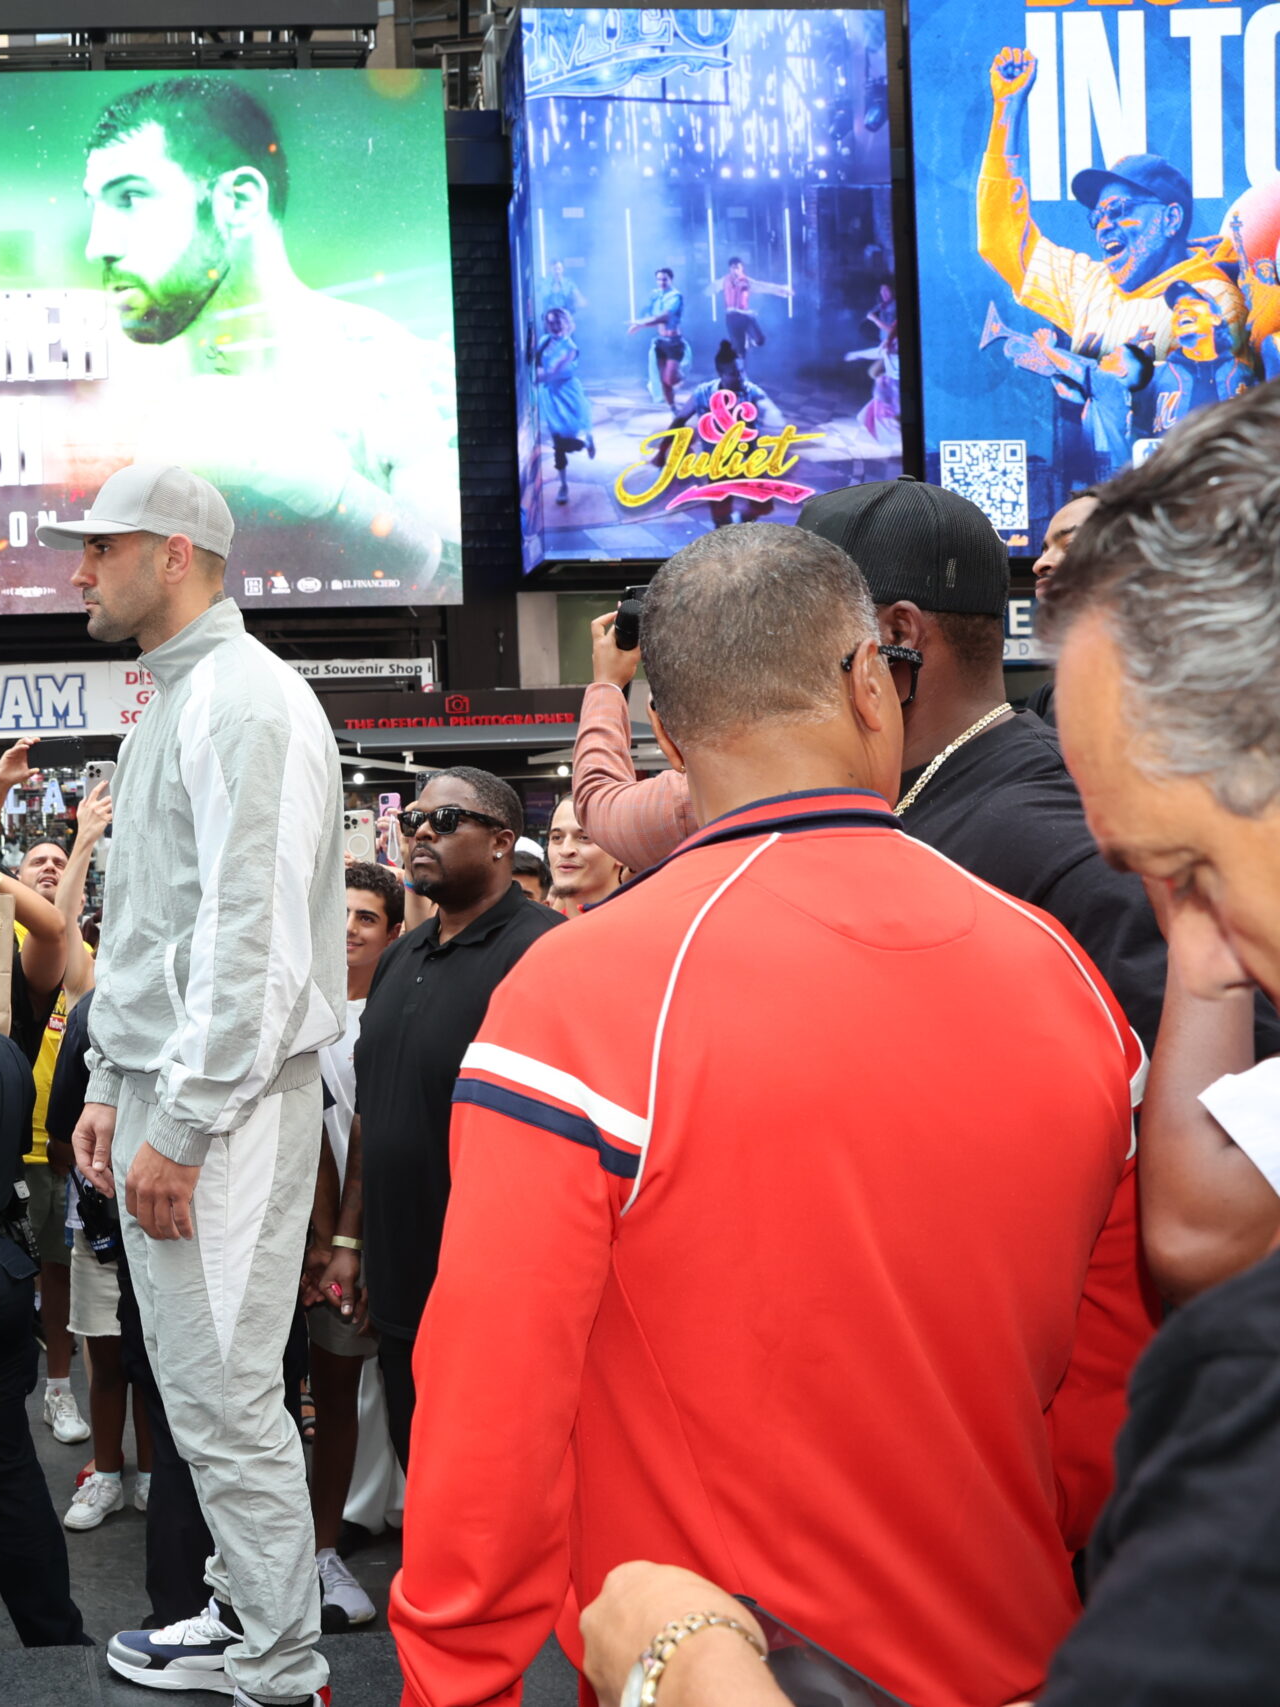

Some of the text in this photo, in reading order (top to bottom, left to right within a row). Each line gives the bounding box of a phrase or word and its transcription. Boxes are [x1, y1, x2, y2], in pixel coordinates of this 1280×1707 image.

[1024, 10, 1148, 201] IN
[697, 388, 759, 443] &
[614, 421, 827, 508] Juliet
[324, 663, 385, 675] Souvenir
[389, 663, 423, 676] Shop
[344, 712, 575, 730] THE OFFICIAL PHOTOGRAPHER
